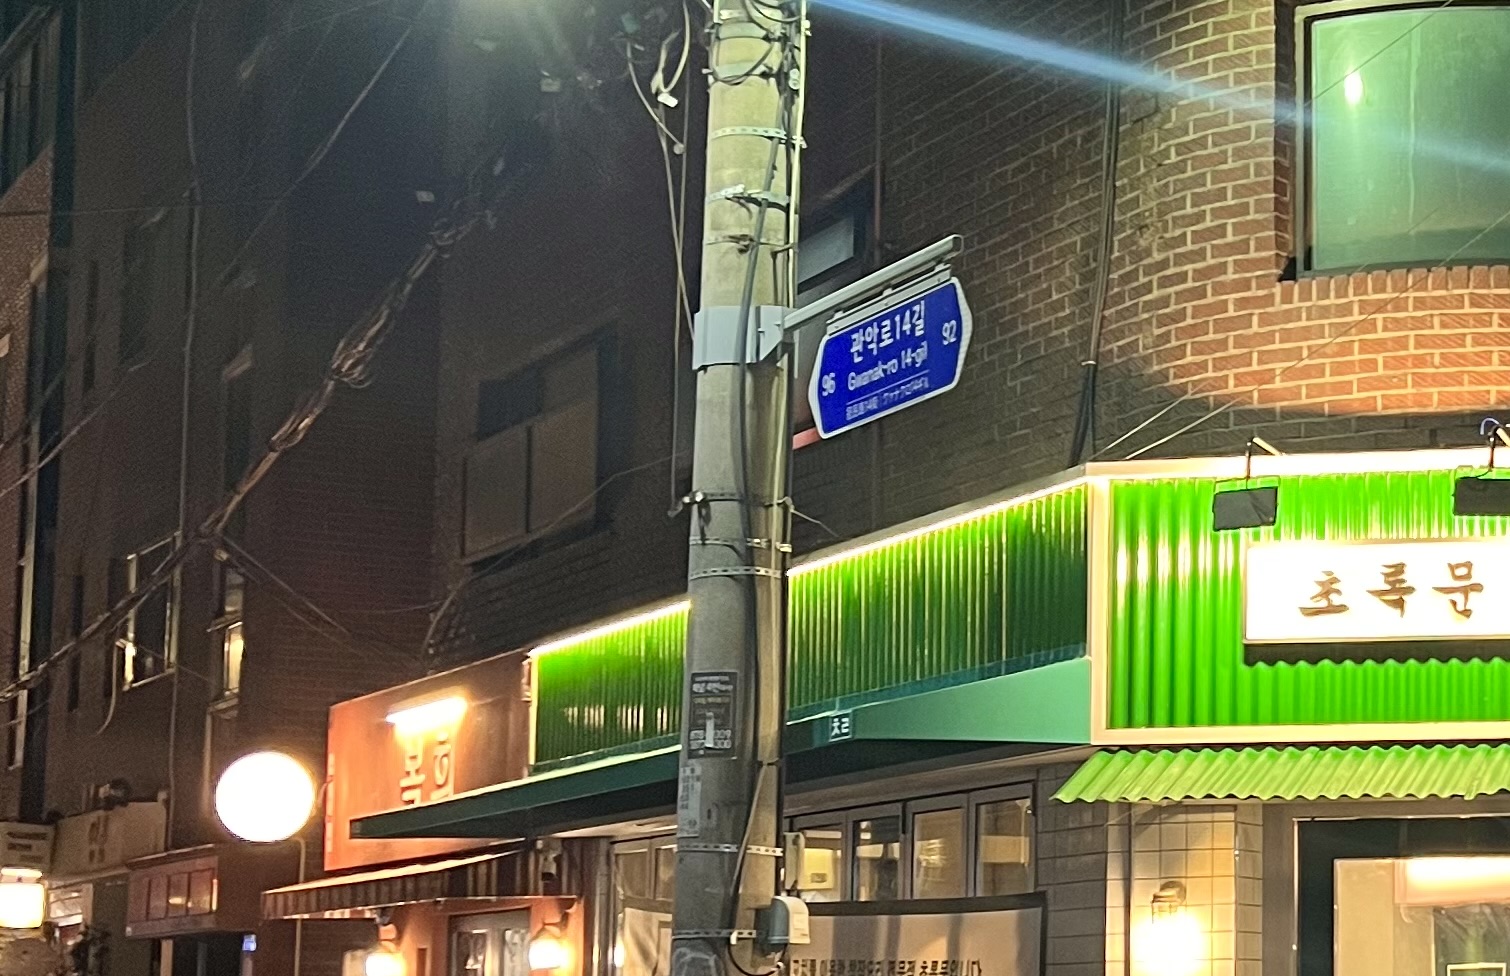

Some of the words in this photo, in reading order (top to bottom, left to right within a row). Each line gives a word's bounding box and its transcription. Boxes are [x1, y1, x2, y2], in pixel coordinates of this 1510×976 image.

[850, 300, 925, 363] 관악로14길
[941, 319, 958, 346] 92
[821, 372, 836, 397] 96
[1298, 561, 1484, 619] 초록문
